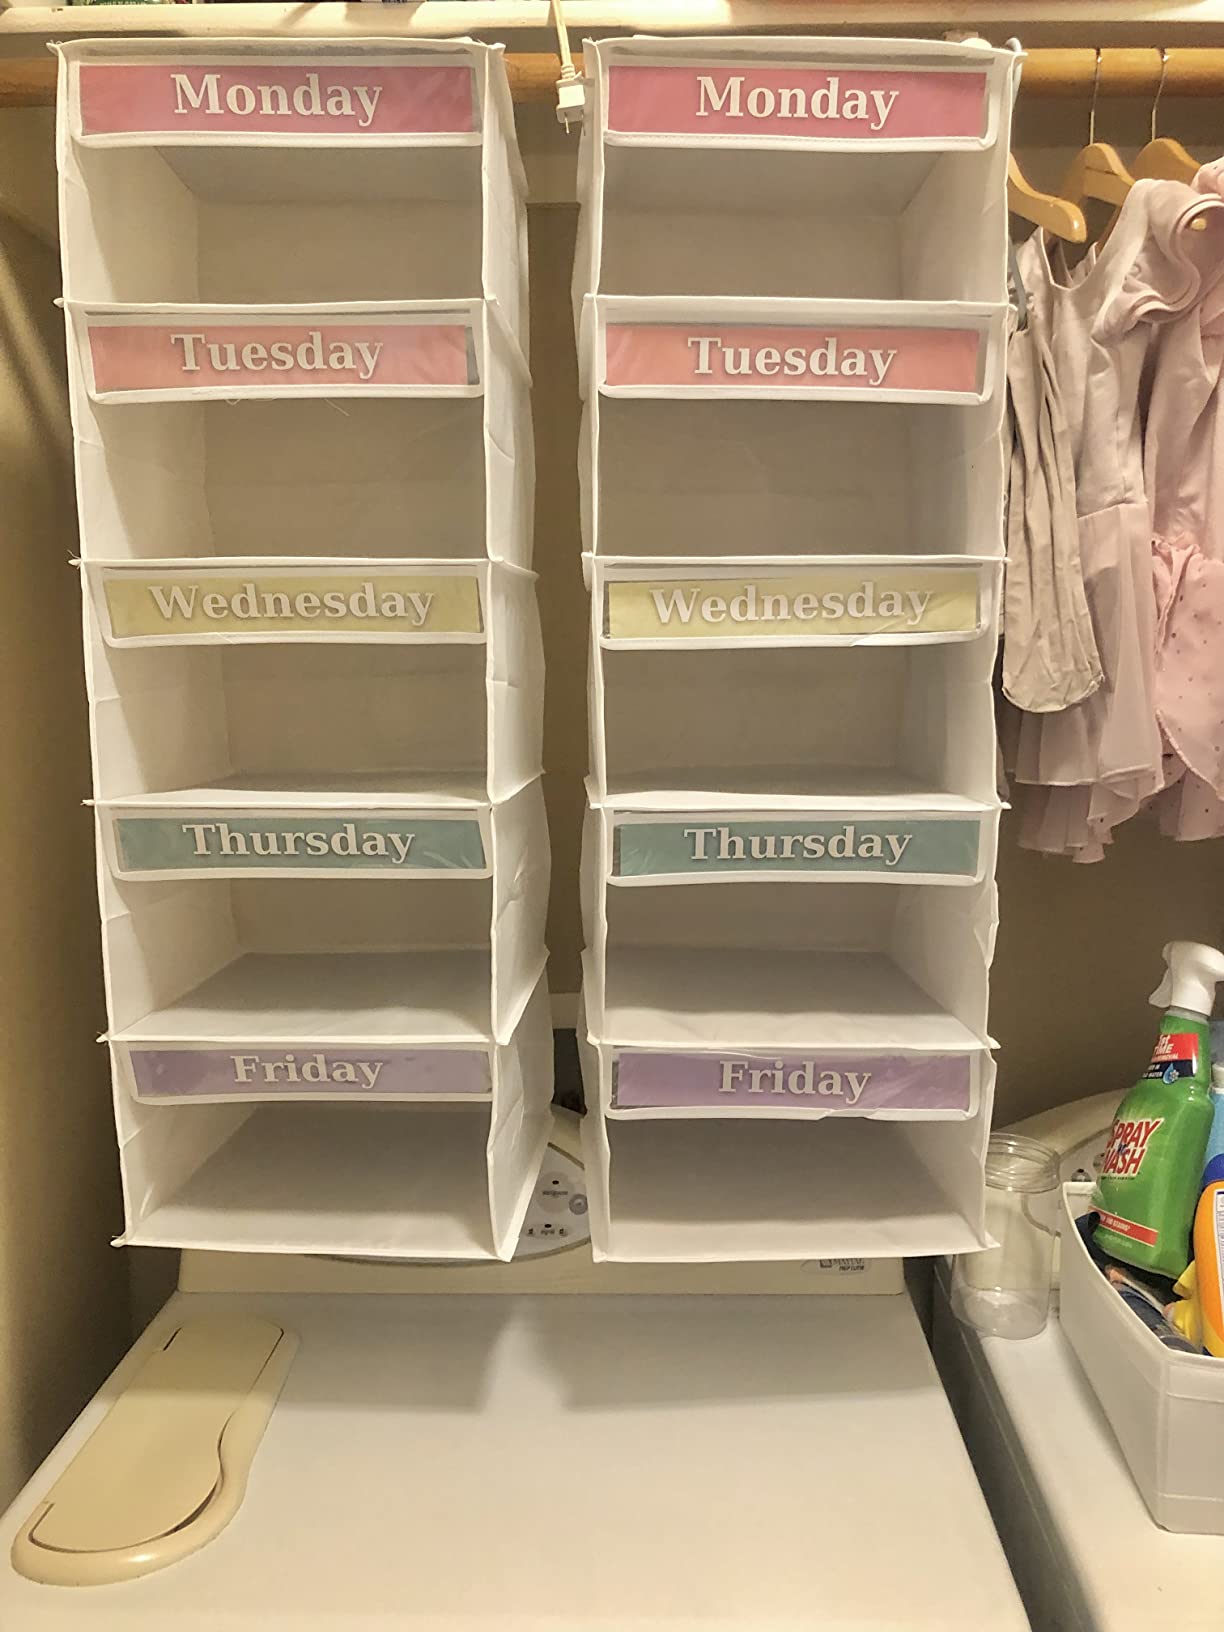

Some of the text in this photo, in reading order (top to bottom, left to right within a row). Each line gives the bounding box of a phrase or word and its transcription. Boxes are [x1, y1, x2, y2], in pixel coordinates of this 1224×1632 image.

[171, 73, 384, 128] Monday
[696, 75, 900, 131] Monday
[171, 332, 384, 380] Tuesday
[687, 337, 897, 387] Tuesday
[149, 582, 434, 626] Wednesday
[650, 581, 932, 628] Wednesday
[182, 823, 416, 865] Thursday
[683, 825, 914, 866] Thursday
[230, 1053, 384, 1090] Friday
[718, 1060, 872, 1105] Friday
